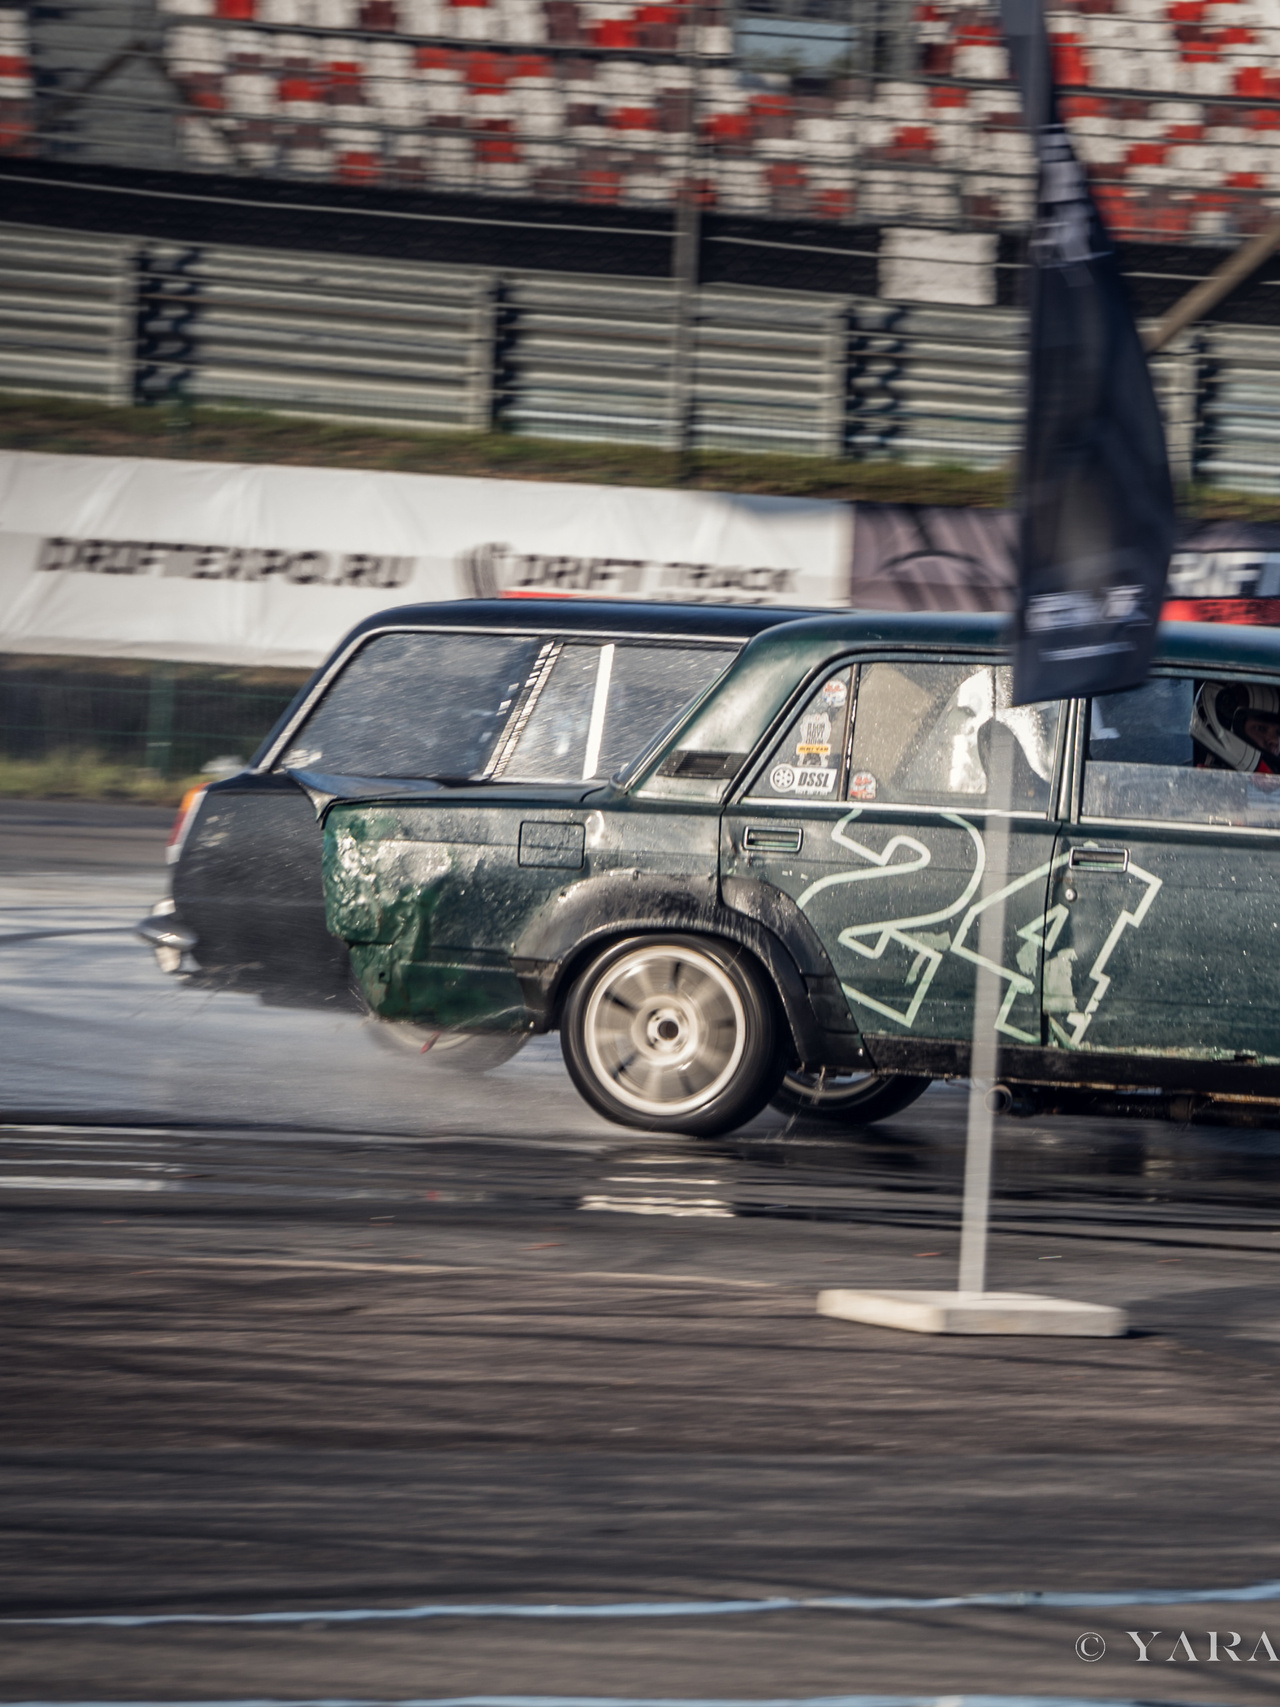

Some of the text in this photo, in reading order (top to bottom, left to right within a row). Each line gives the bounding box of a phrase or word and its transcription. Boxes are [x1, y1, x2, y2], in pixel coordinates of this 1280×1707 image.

[38, 535, 415, 592] DRIFTEXPO.RU
[515, 555, 651, 592] DRIFT
[797, 771, 830, 788] DSSL
